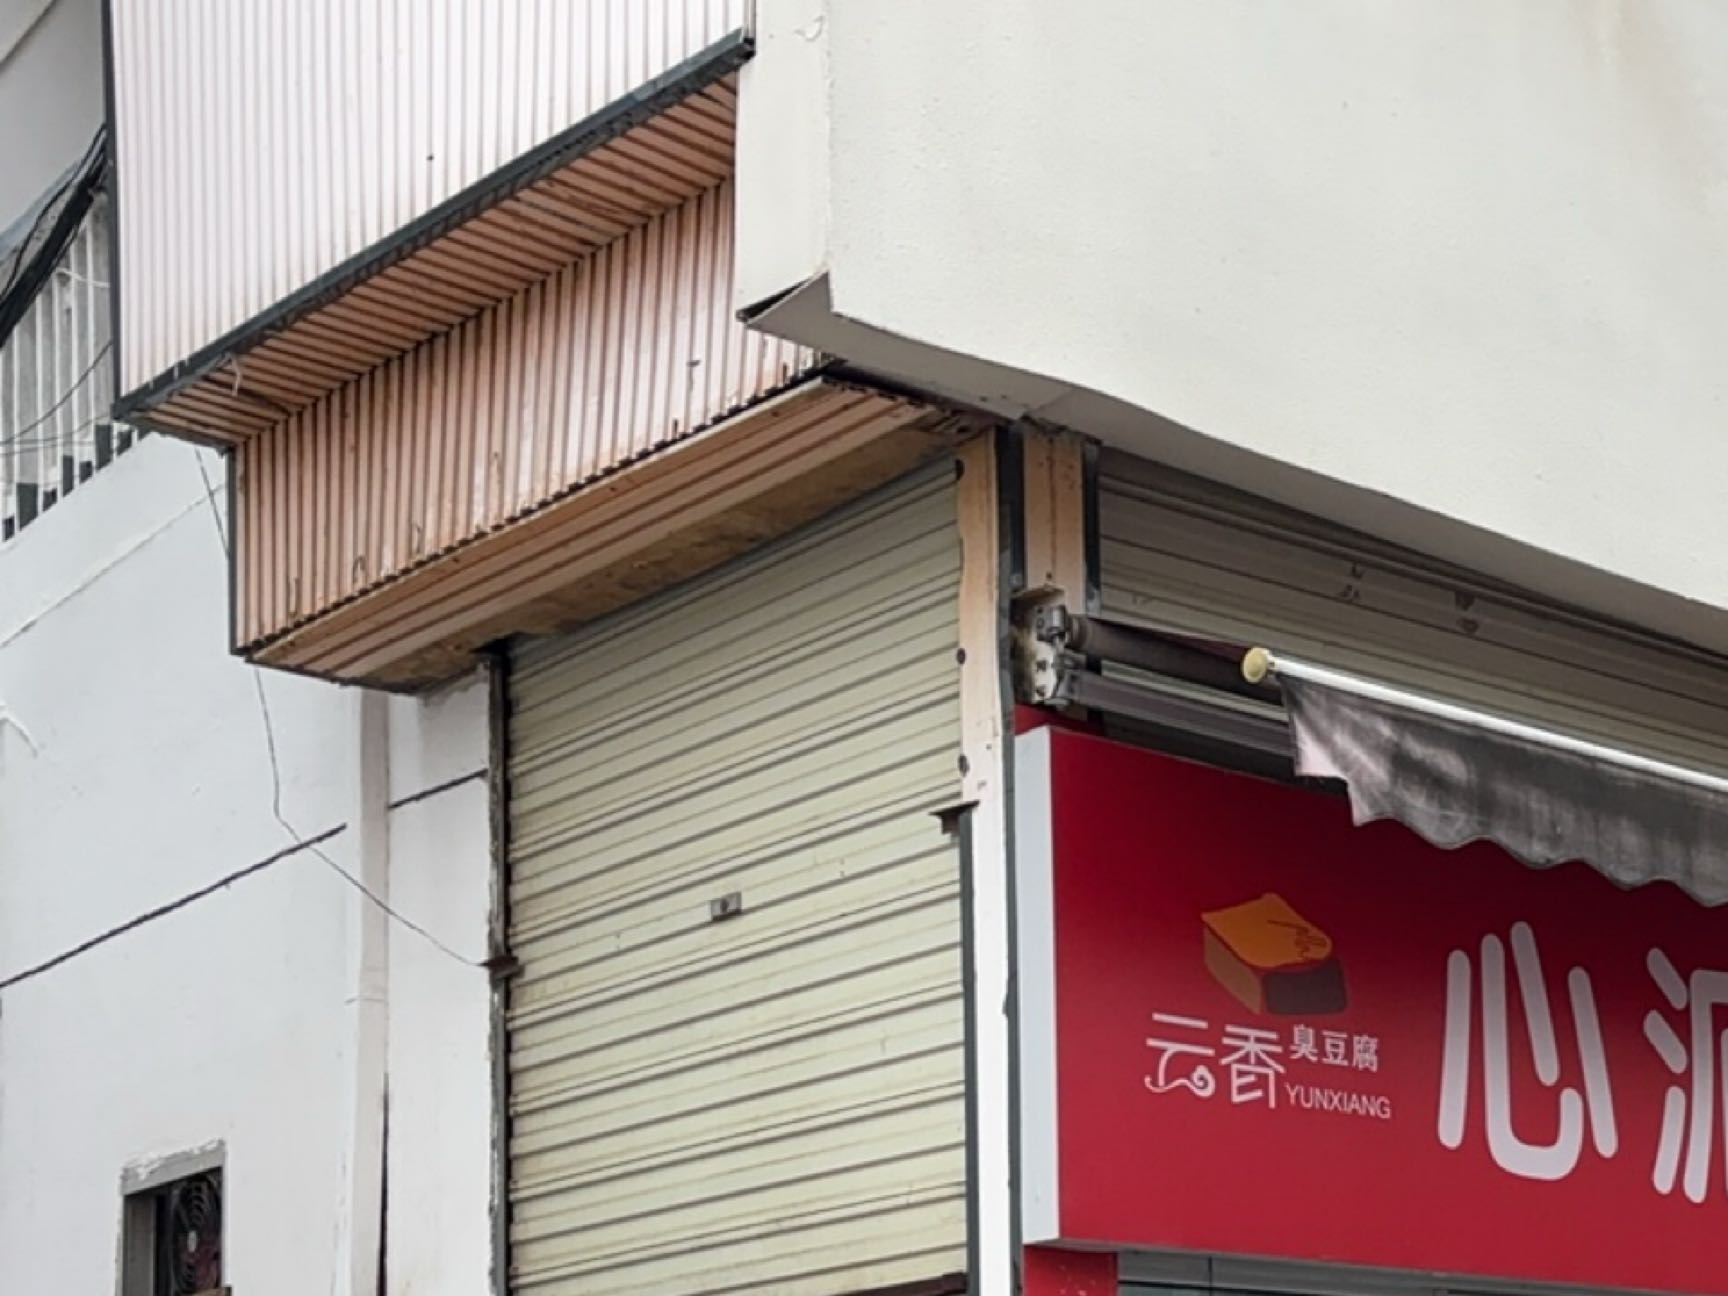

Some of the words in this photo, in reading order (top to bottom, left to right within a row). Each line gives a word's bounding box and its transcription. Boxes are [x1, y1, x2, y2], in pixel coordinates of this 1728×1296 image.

[1145, 1012, 1286, 1109] 云香
[1291, 1024, 1380, 1072] 臭豆腐
[1284, 1082, 1392, 1120] YUNXIANG
